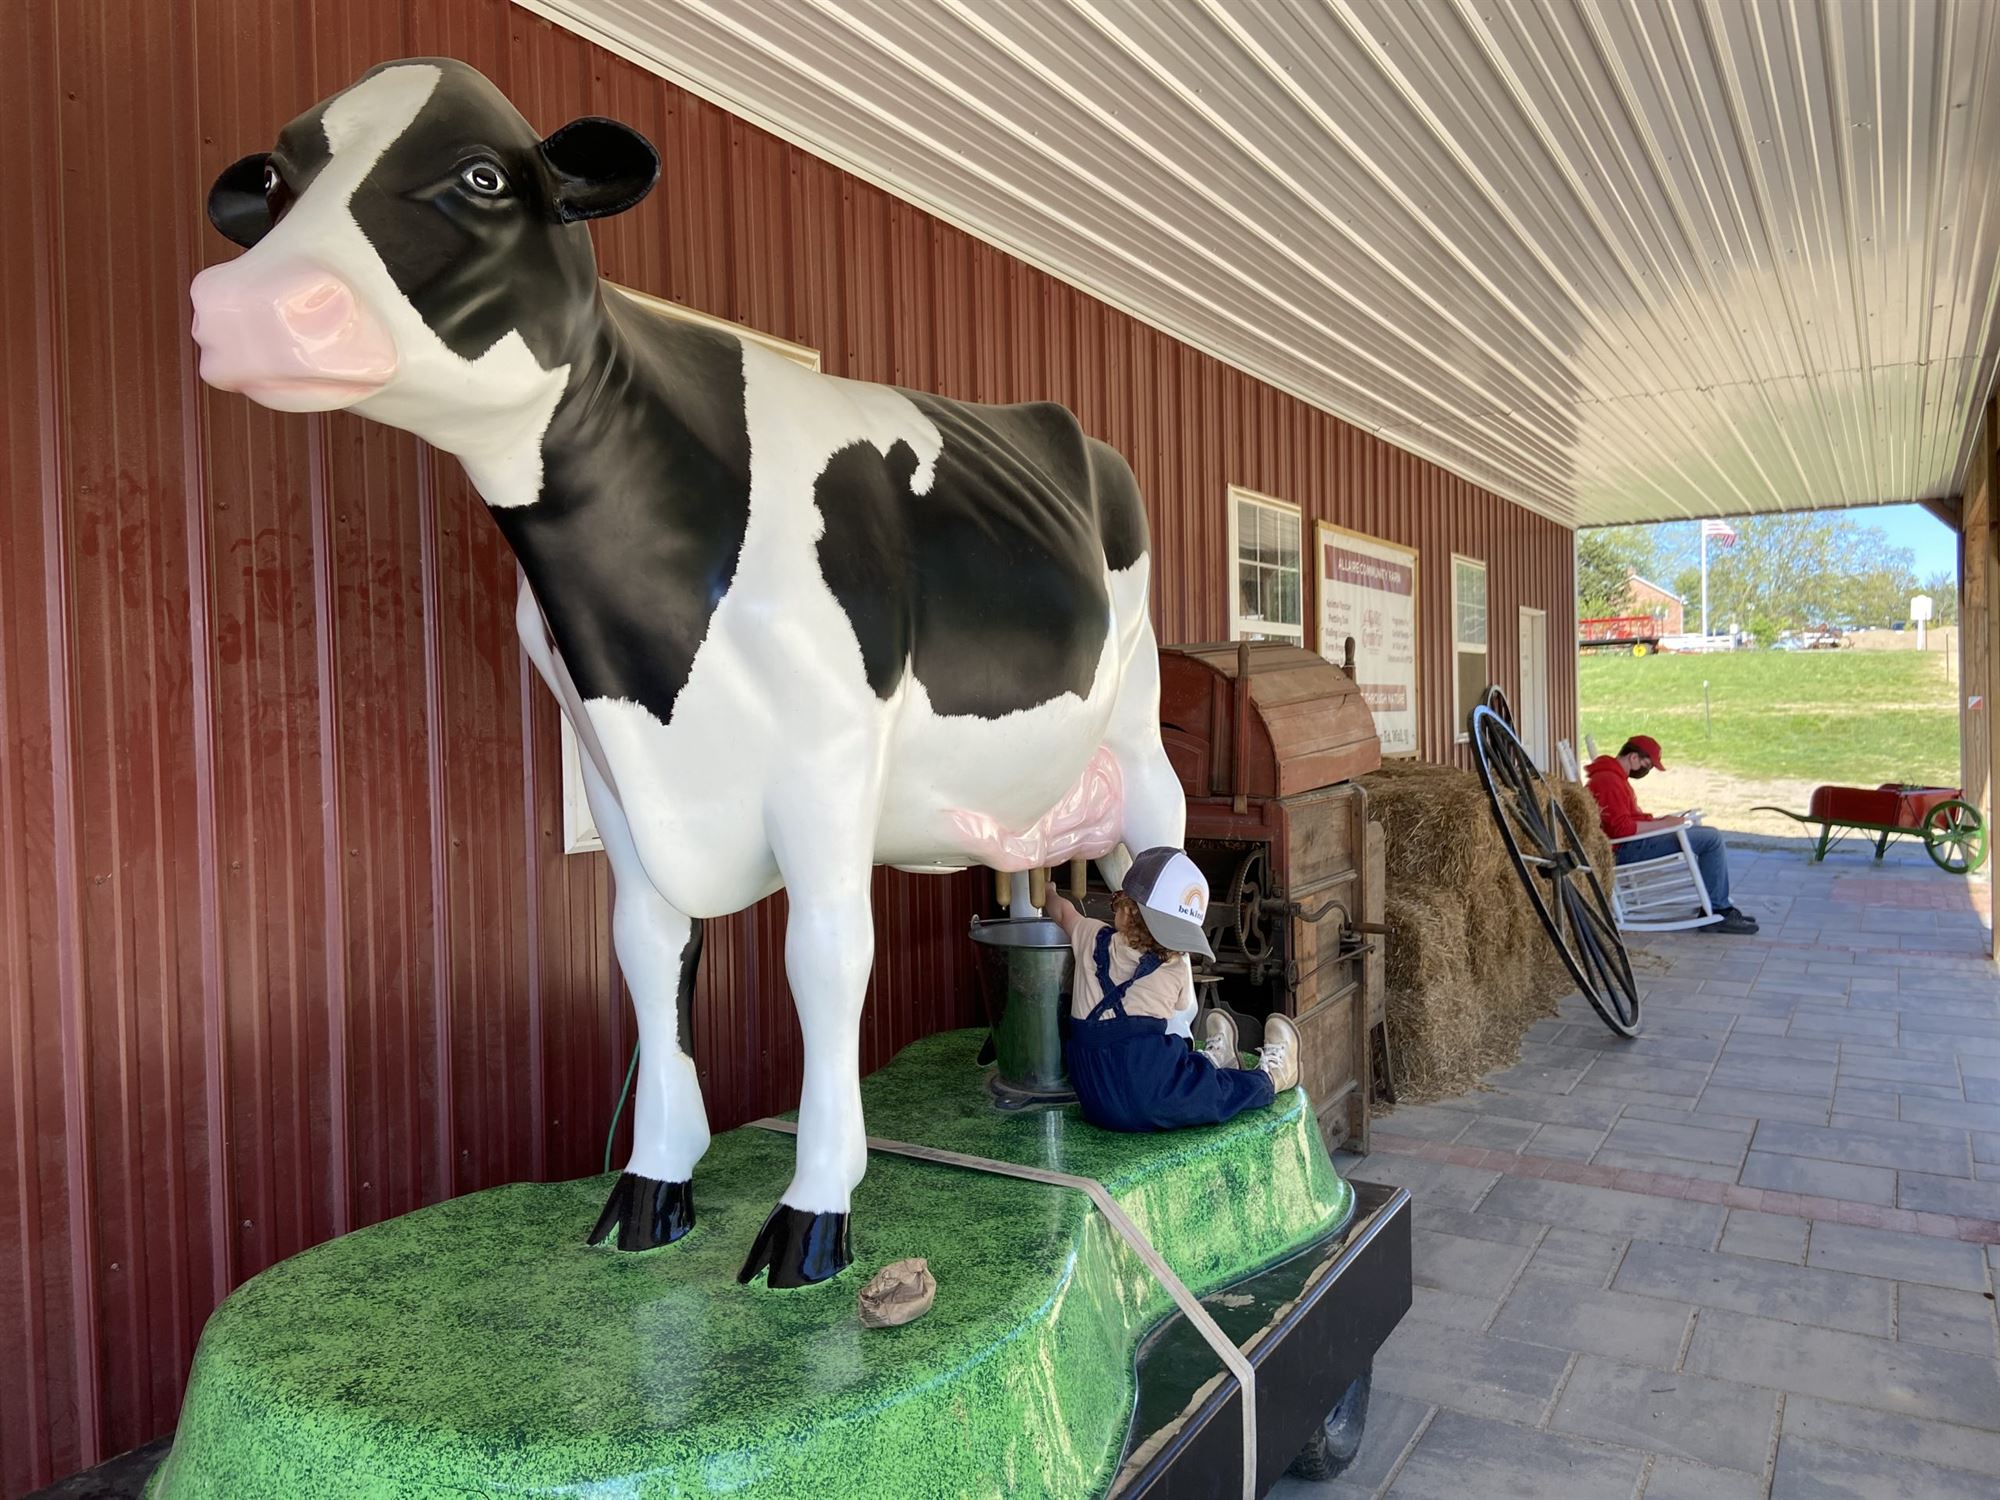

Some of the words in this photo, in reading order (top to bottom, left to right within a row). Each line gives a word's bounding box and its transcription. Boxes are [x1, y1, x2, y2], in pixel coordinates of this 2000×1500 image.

[1338, 558, 1360, 574] ALLAIRE
[1360, 561, 1389, 580] COMMUNITY
[1389, 569, 1402, 584] FARM
[1365, 692, 1388, 705] THROUGH
[1388, 692, 1405, 705] NATURE
[1178, 905, 1189, 914] be
